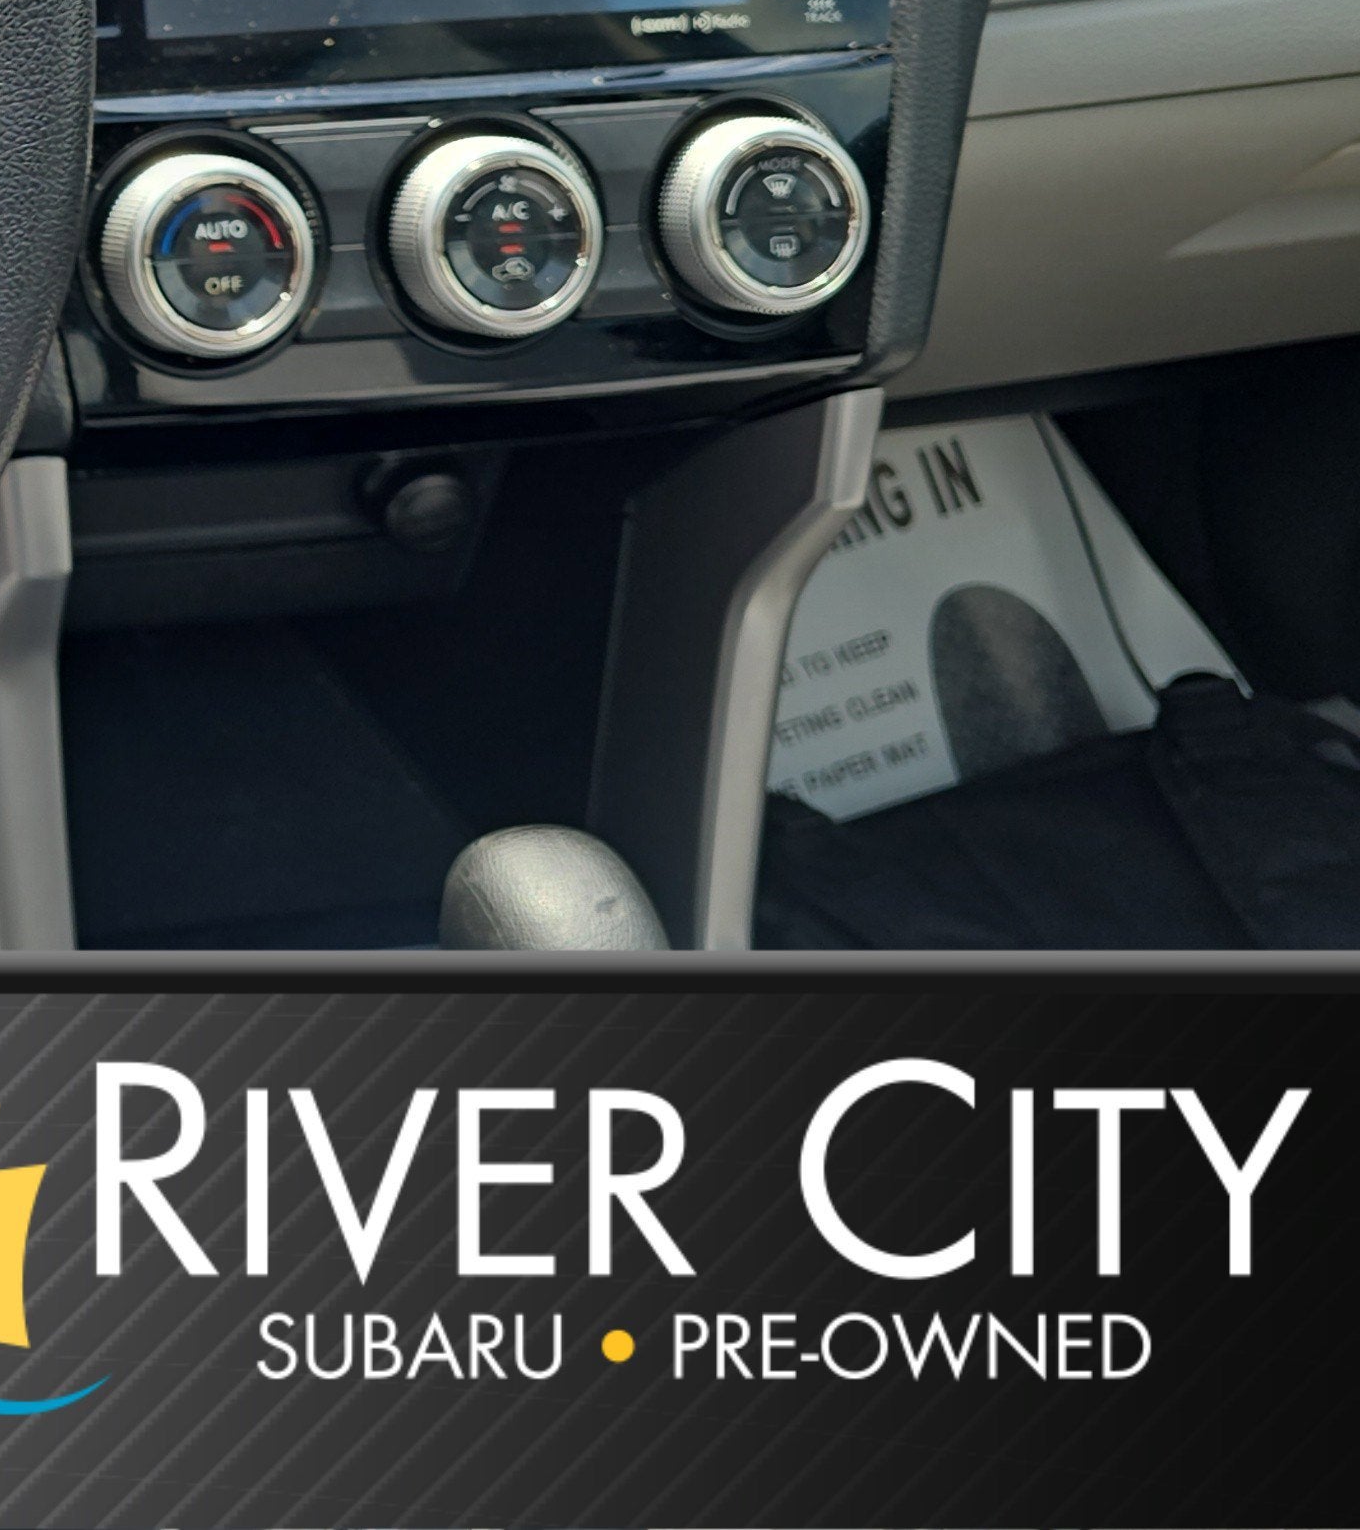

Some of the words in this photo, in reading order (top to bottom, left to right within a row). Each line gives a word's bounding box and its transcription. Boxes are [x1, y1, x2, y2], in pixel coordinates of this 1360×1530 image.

[757, 155, 801, 171] MODE
[491, 200, 531, 221] A/C
[194, 219, 249, 240] AUTO
[204, 275, 244, 295] OFF
[915, 435, 982, 517] IN
[845, 677, 920, 722] CLEAN
